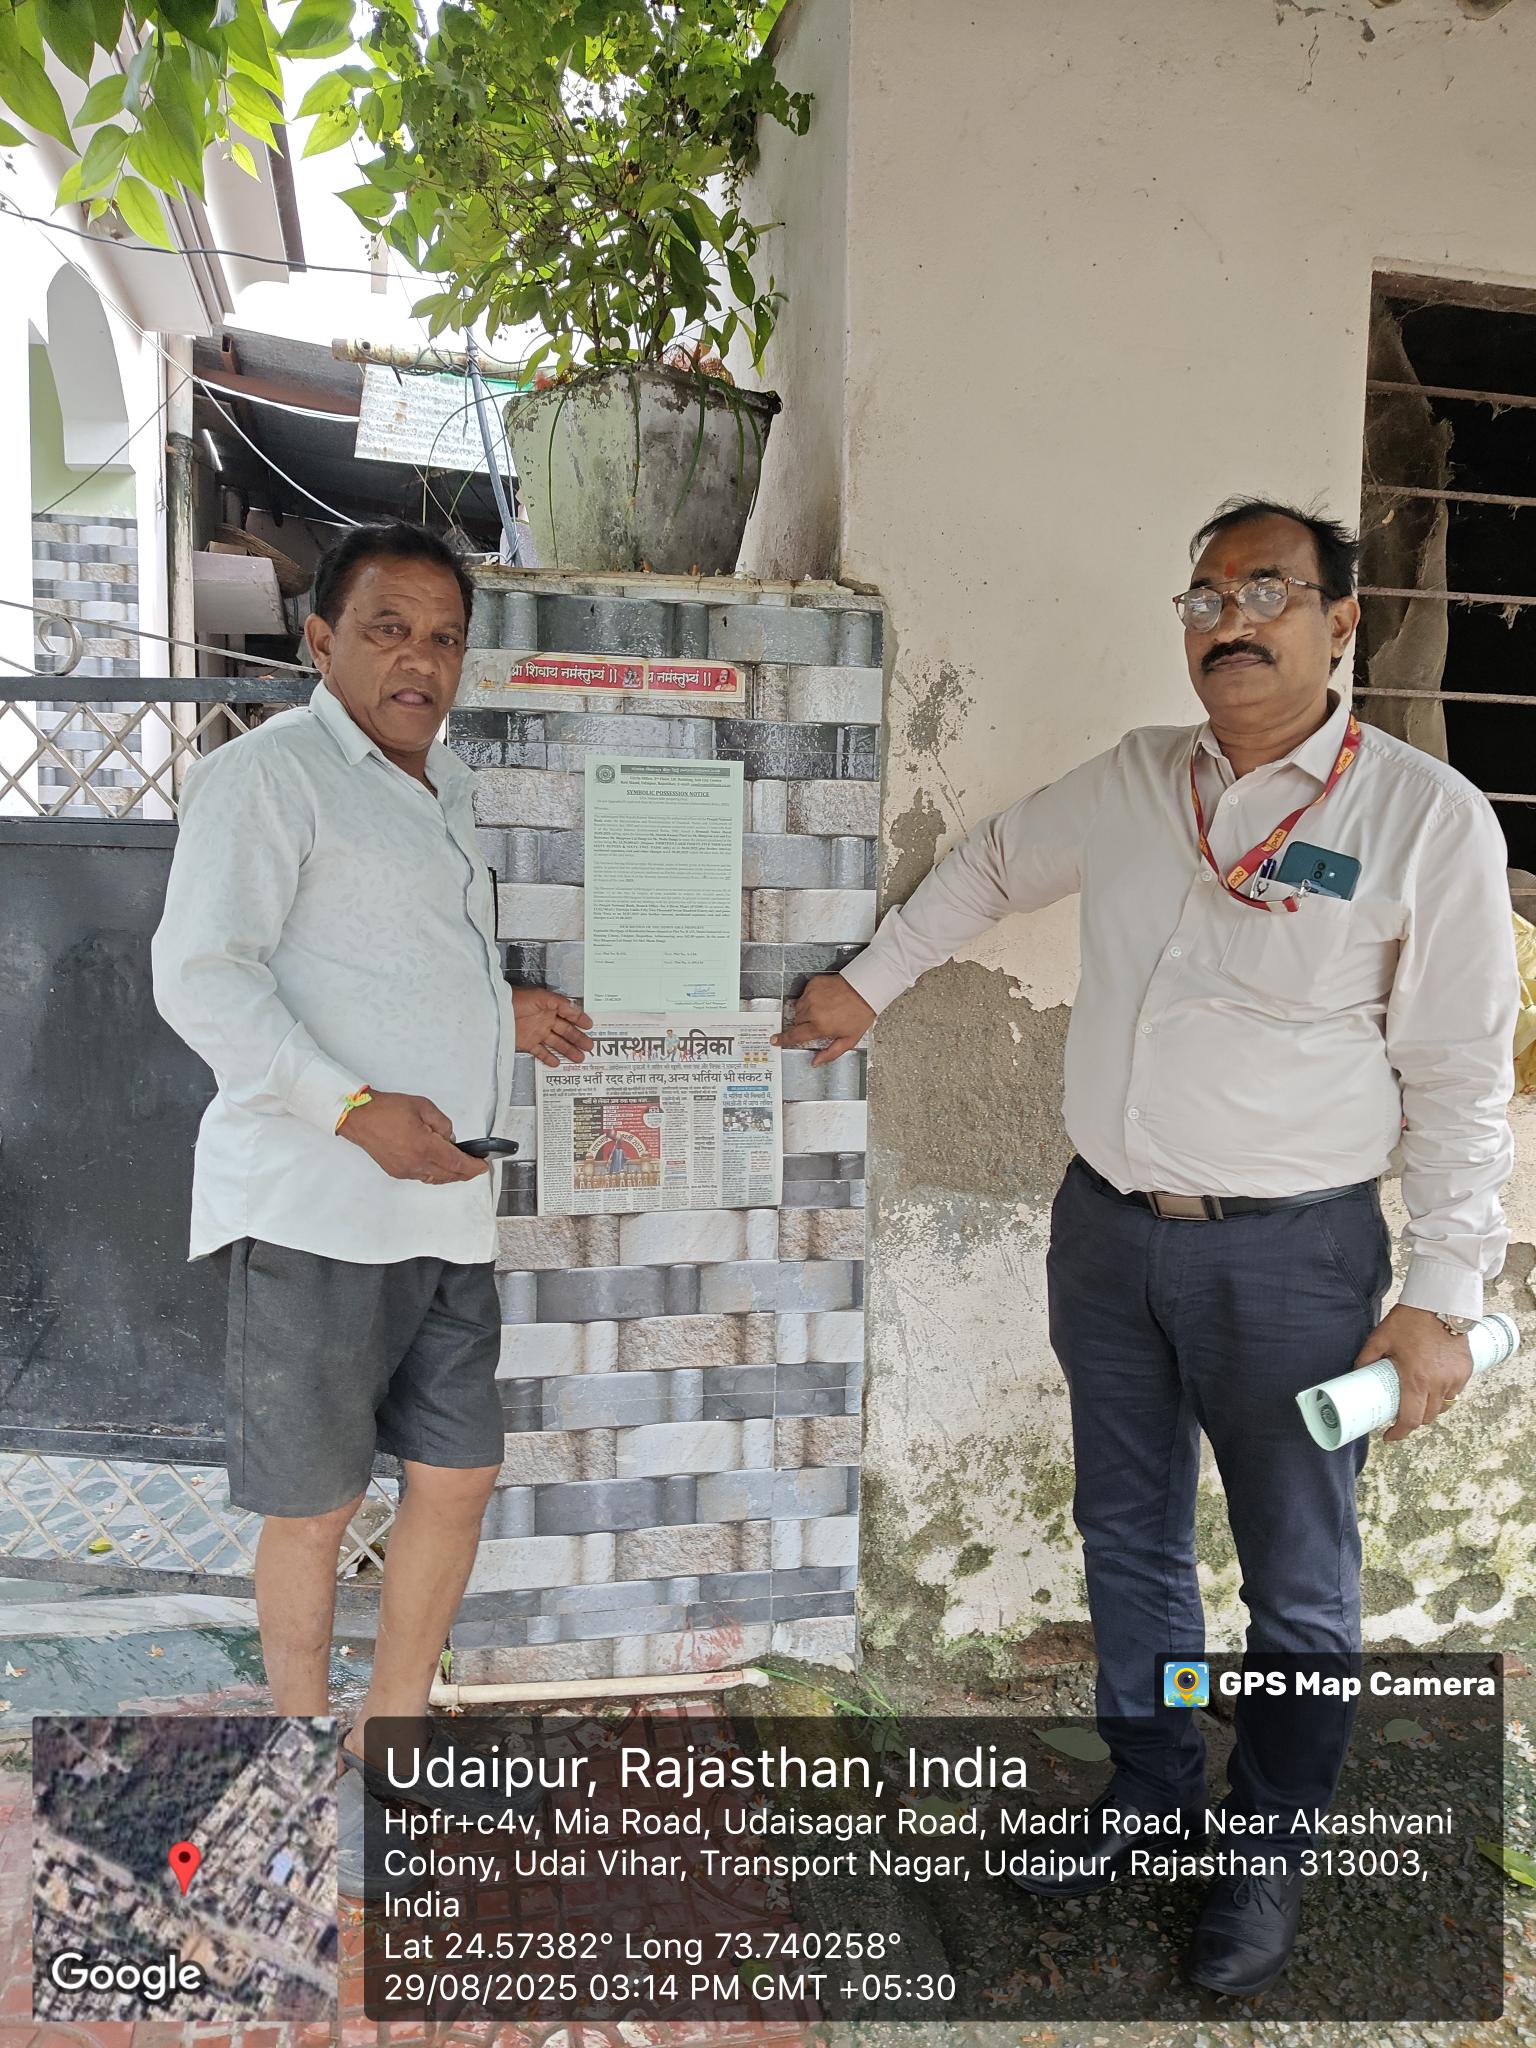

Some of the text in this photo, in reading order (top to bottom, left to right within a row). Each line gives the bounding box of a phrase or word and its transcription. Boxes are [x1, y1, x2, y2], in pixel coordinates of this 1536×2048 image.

[526, 661, 558, 679] शिवाय
[582, 1072, 602, 1084] भर्ती
[626, 1071, 646, 1084] होना
[723, 1070, 735, 1082] भी
[737, 1070, 762, 1082] संकट
[764, 1069, 773, 1082] में
